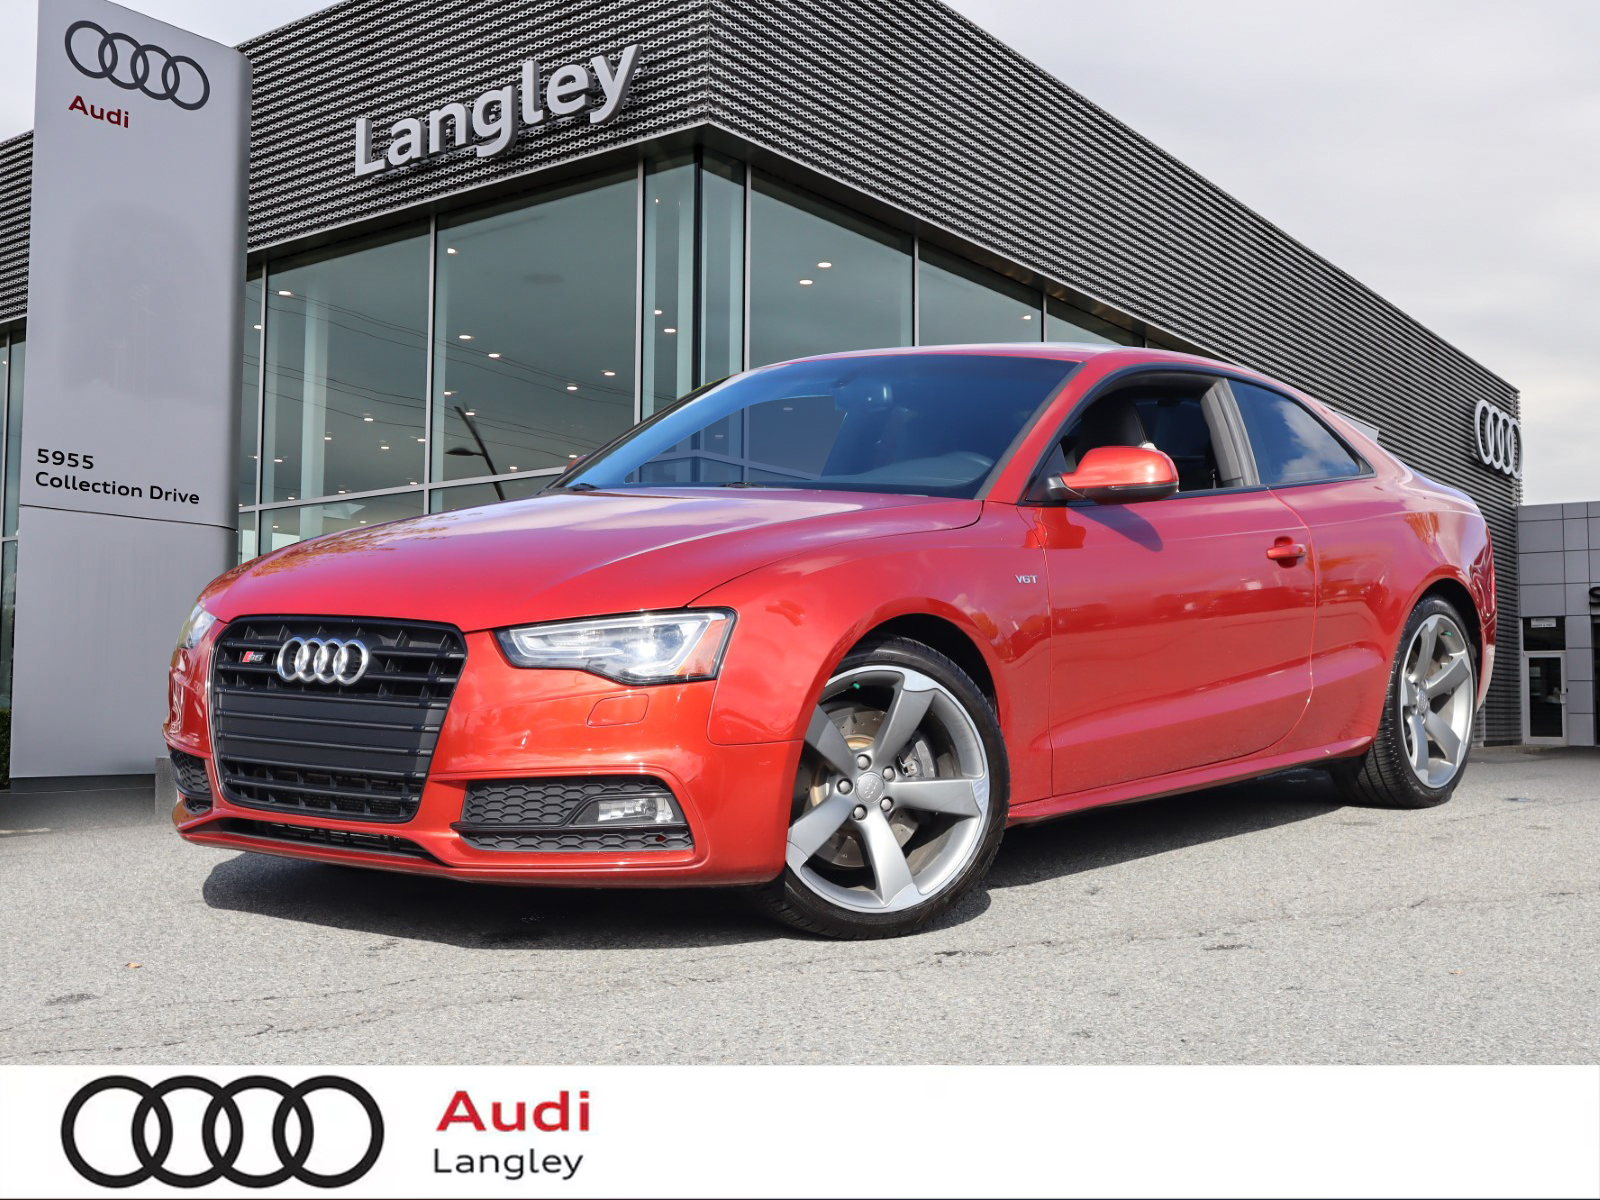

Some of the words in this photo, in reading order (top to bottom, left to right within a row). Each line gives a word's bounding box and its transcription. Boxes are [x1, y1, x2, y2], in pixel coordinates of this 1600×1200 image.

[68, 95, 129, 128] Audi
[354, 43, 643, 177] Langley
[37, 448, 94, 470] 5955
[35, 471, 143, 498] Collection
[149, 485, 200, 504] Drive
